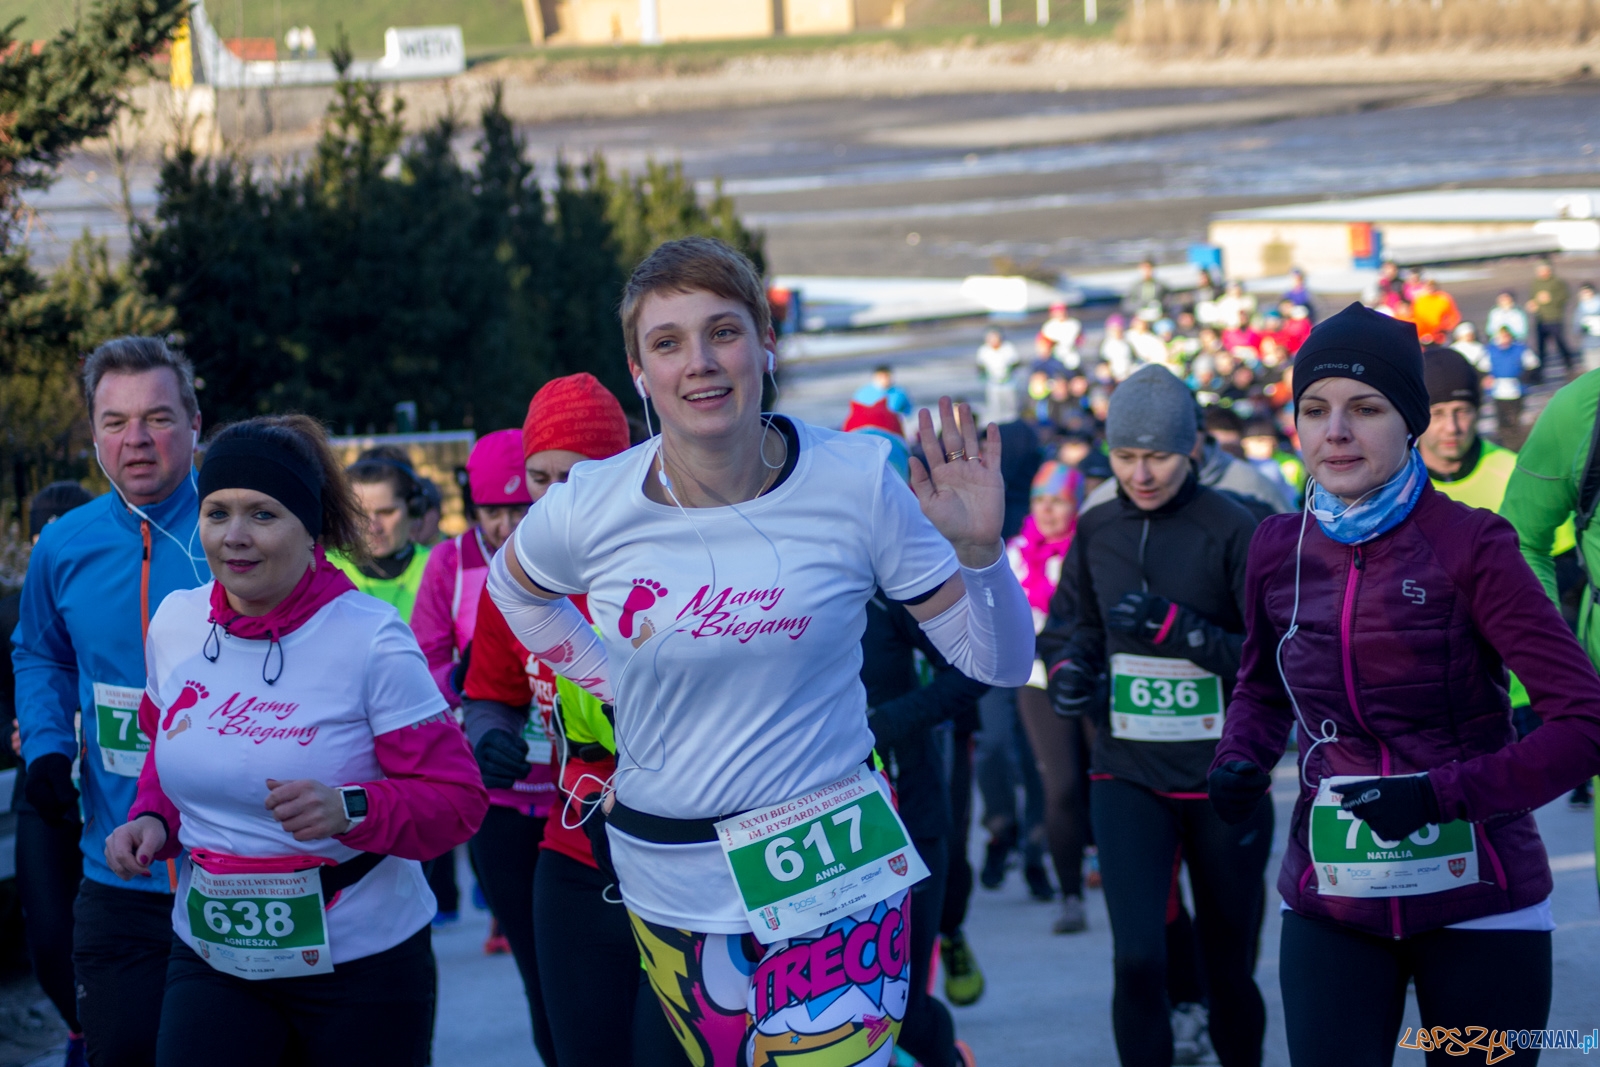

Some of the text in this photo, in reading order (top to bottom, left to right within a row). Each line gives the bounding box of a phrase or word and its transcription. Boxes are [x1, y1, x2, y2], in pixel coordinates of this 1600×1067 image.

[1313, 363, 1349, 371] ARTENGO
[675, 584, 785, 621] Mamy
[208, 692, 300, 720] Mamy
[1129, 677, 1200, 709] 636
[738, 773, 862, 830] XXXII BIEG SYLWESTROWY
[748, 829, 766, 841] IM.
[766, 805, 822, 834] RYSZARDA
[822, 785, 865, 810] BURGIELA
[764, 804, 863, 882] 617
[1367, 850, 1413, 860] NATALIA
[213, 879, 235, 887] BIEG
[236, 876, 308, 887] SYLWESTROWY
[815, 862, 846, 883] ANNA
[208, 888, 257, 896] RYSZARDA
[258, 887, 305, 896] BURGIELA
[203, 900, 295, 938] 638
[224, 937, 278, 947] AGNIESZKA
